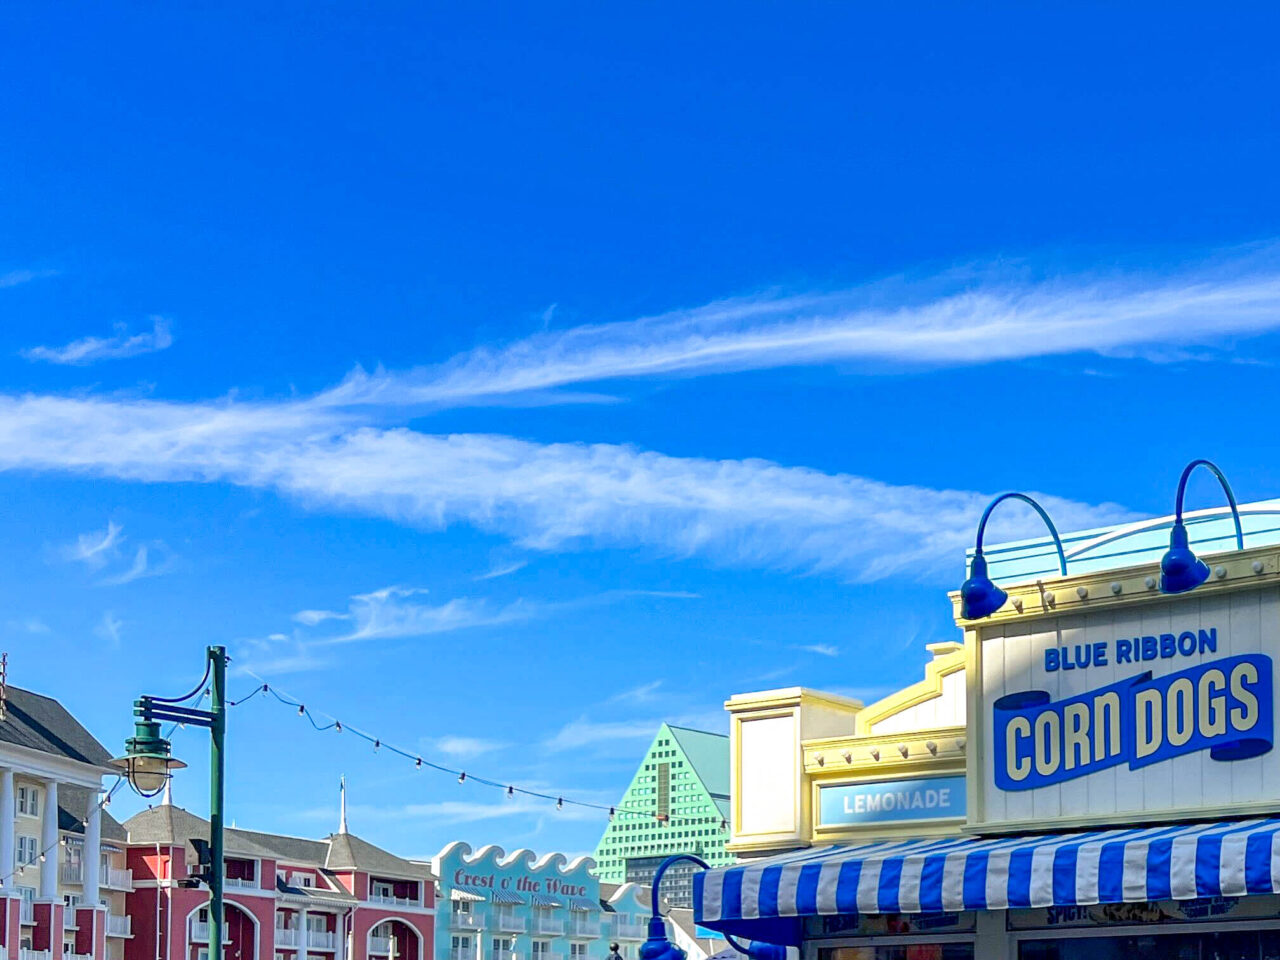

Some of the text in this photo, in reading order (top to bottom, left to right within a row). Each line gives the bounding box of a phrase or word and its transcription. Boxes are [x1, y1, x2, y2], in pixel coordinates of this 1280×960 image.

[1044, 628, 1217, 672] BLUE RIBBON
[1006, 662, 1259, 781] CORN DOGS
[843, 788, 951, 814] LEMONADE
[454, 869, 494, 888] Crest
[516, 875, 541, 892] the
[545, 878, 587, 896] Wave
